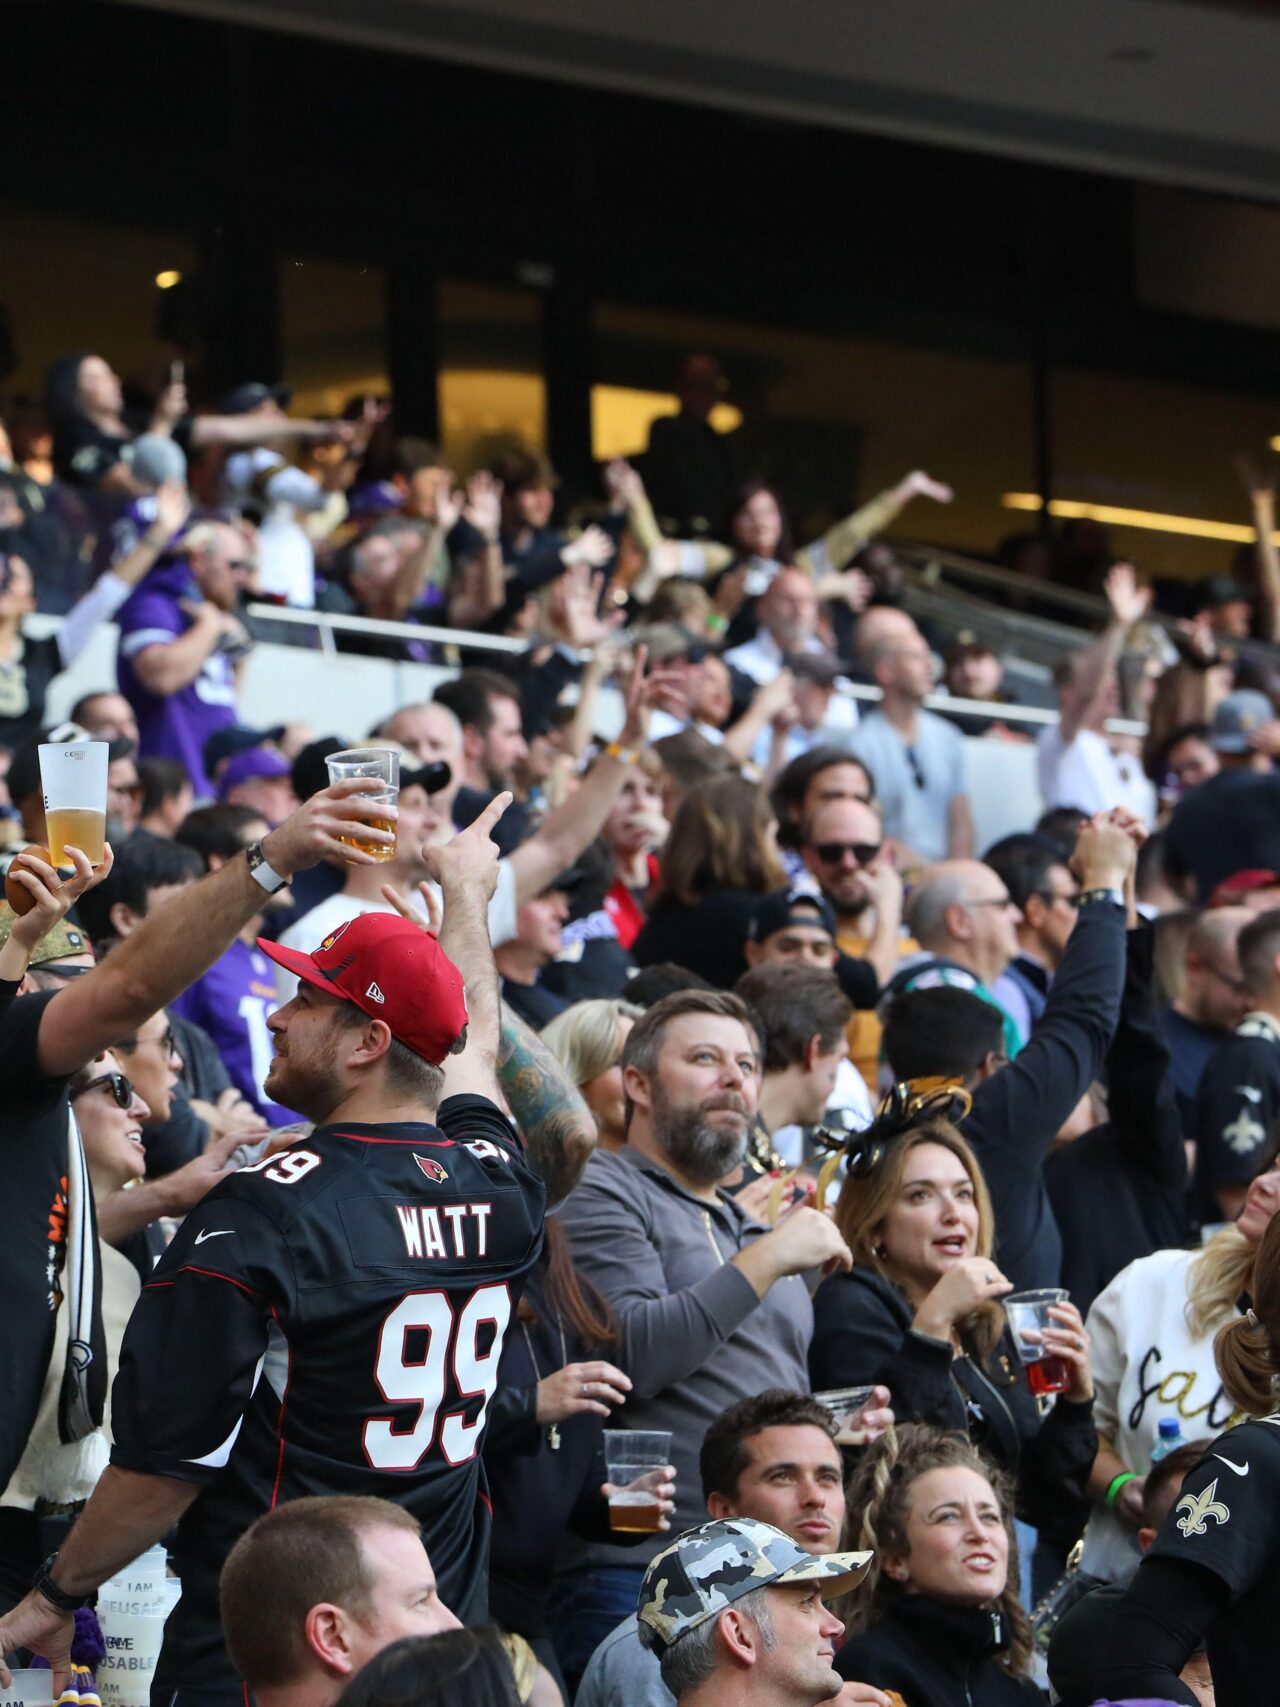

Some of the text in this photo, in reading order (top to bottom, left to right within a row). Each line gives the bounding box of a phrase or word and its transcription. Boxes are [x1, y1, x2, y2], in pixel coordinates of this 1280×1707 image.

[395, 1203, 492, 1259] WATT
[362, 1281, 512, 1472] 99
[134, 1582, 153, 1593] AM
